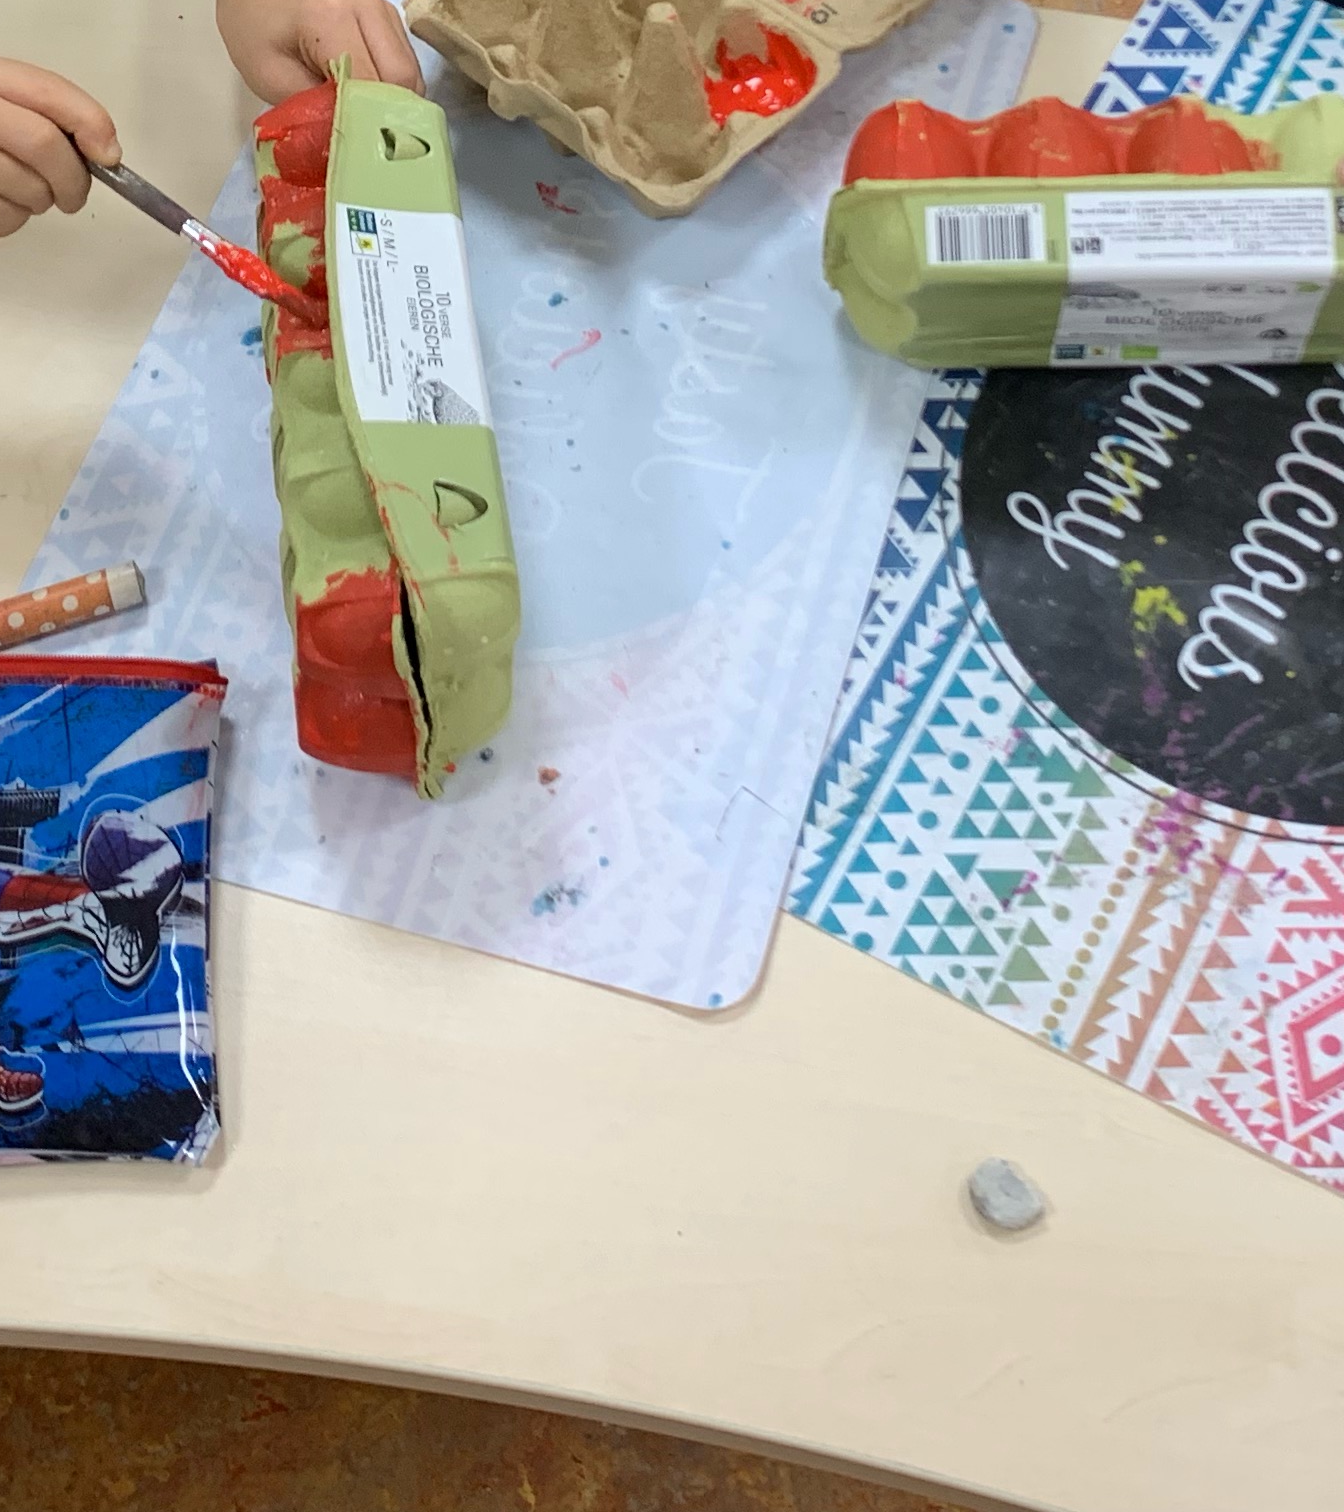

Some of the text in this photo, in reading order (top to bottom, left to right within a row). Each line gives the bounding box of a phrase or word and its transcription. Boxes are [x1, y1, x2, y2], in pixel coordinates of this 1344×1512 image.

[406, 296, 419, 331] EIEREN
[413, 264, 443, 368] BIOLOGISCHE
[435, 291, 452, 339] 10 VERSE
[1006, 362, 1280, 571] ummy
